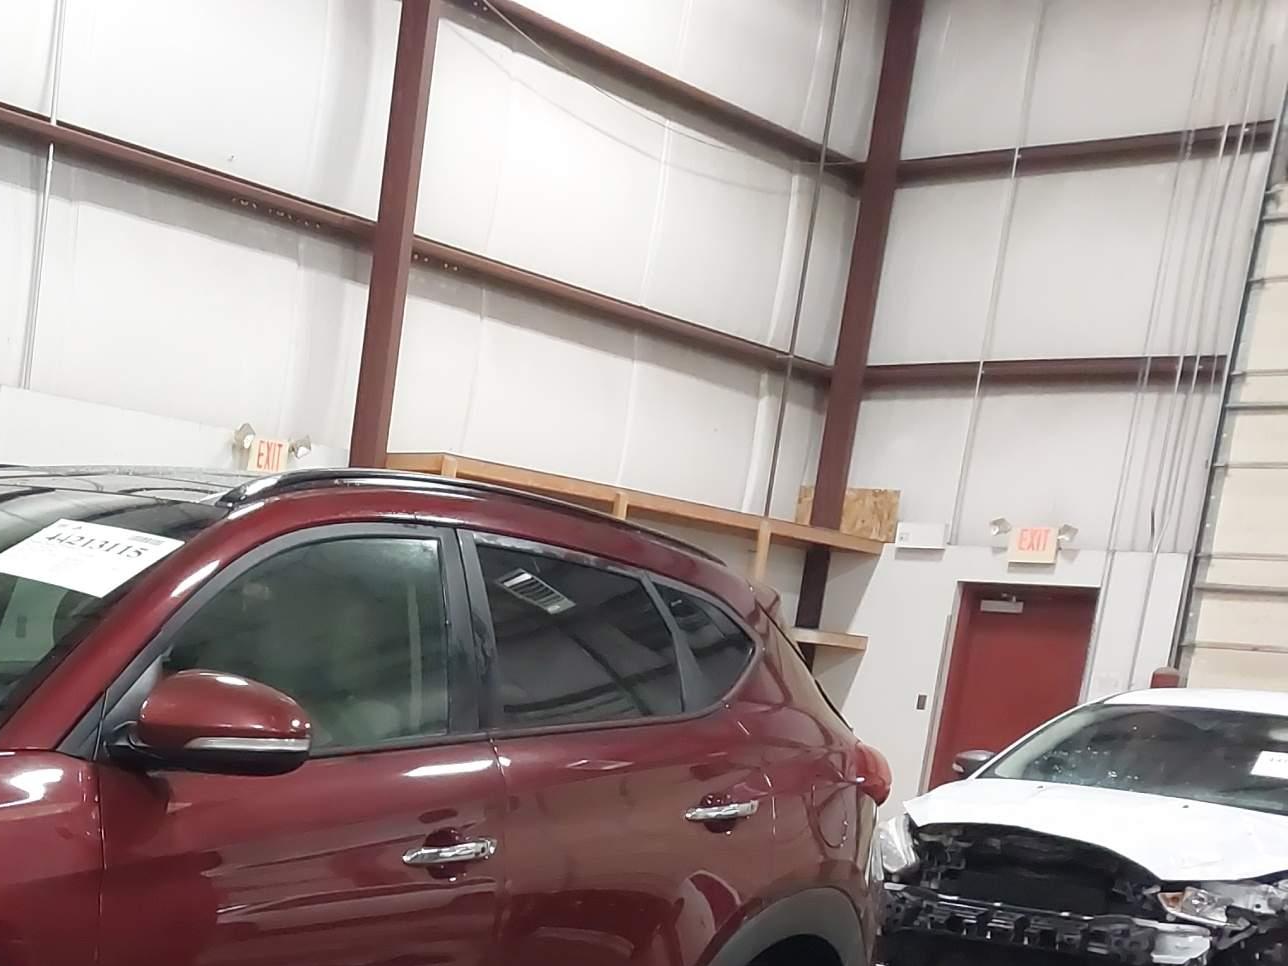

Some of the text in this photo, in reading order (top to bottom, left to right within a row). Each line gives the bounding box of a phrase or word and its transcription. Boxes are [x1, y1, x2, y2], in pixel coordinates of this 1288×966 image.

[256, 440, 283, 471] EXIT
[45, 532, 149, 558] 44213115
[1017, 528, 1051, 552] EXIT
